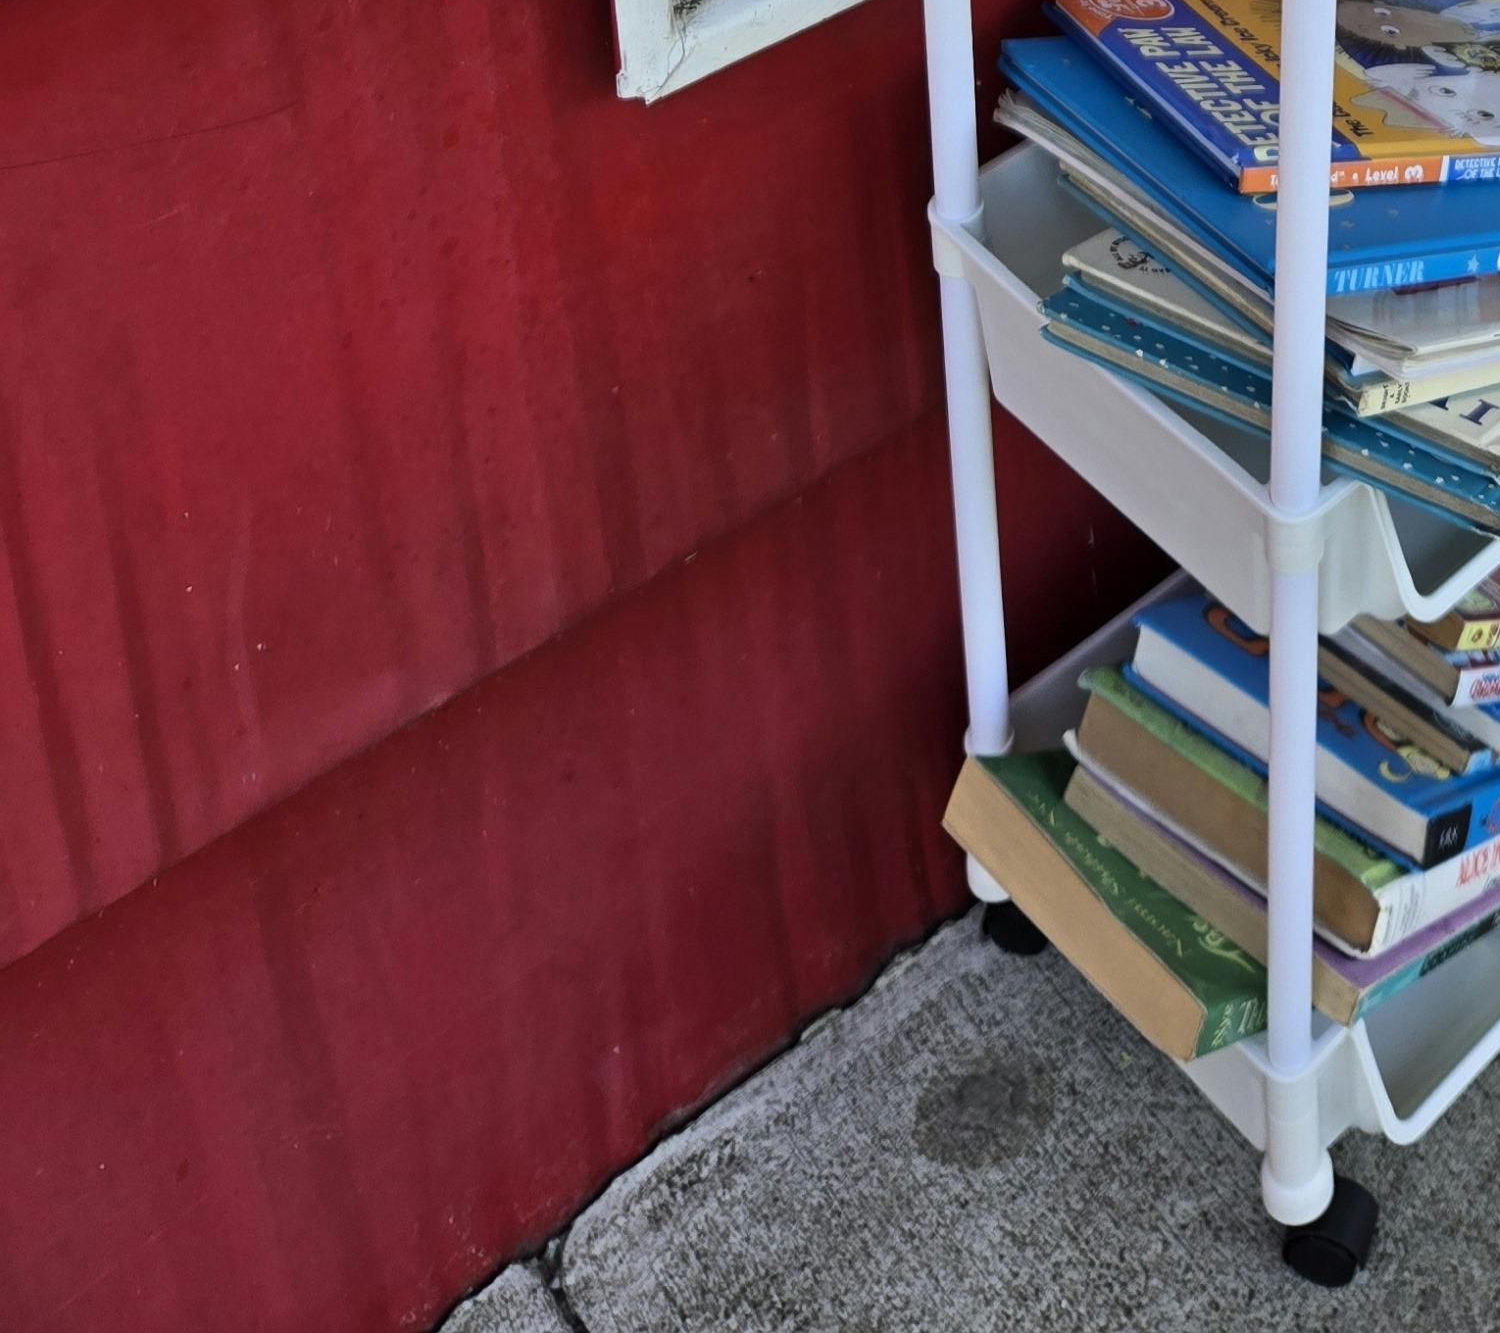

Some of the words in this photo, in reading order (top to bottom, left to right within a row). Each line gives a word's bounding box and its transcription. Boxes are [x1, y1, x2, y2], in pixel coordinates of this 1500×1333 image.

[1118, 27, 1181, 58] PAW
[1160, 26, 1225, 57] LAW
[1233, 25, 1258, 43] Ice
[1200, 60, 1265, 94] THE
[1156, 60, 1280, 162] DETECTIVE
[1350, 116, 1374, 139] The
[1365, 166, 1399, 183] Level
[1454, 157, 1496, 171] DETECTIVE
[1464, 168, 1478, 180] OF
[1480, 167, 1495, 179] THE
[1334, 259, 1425, 294] TURNER
[1457, 850, 1489, 889] ALICE
